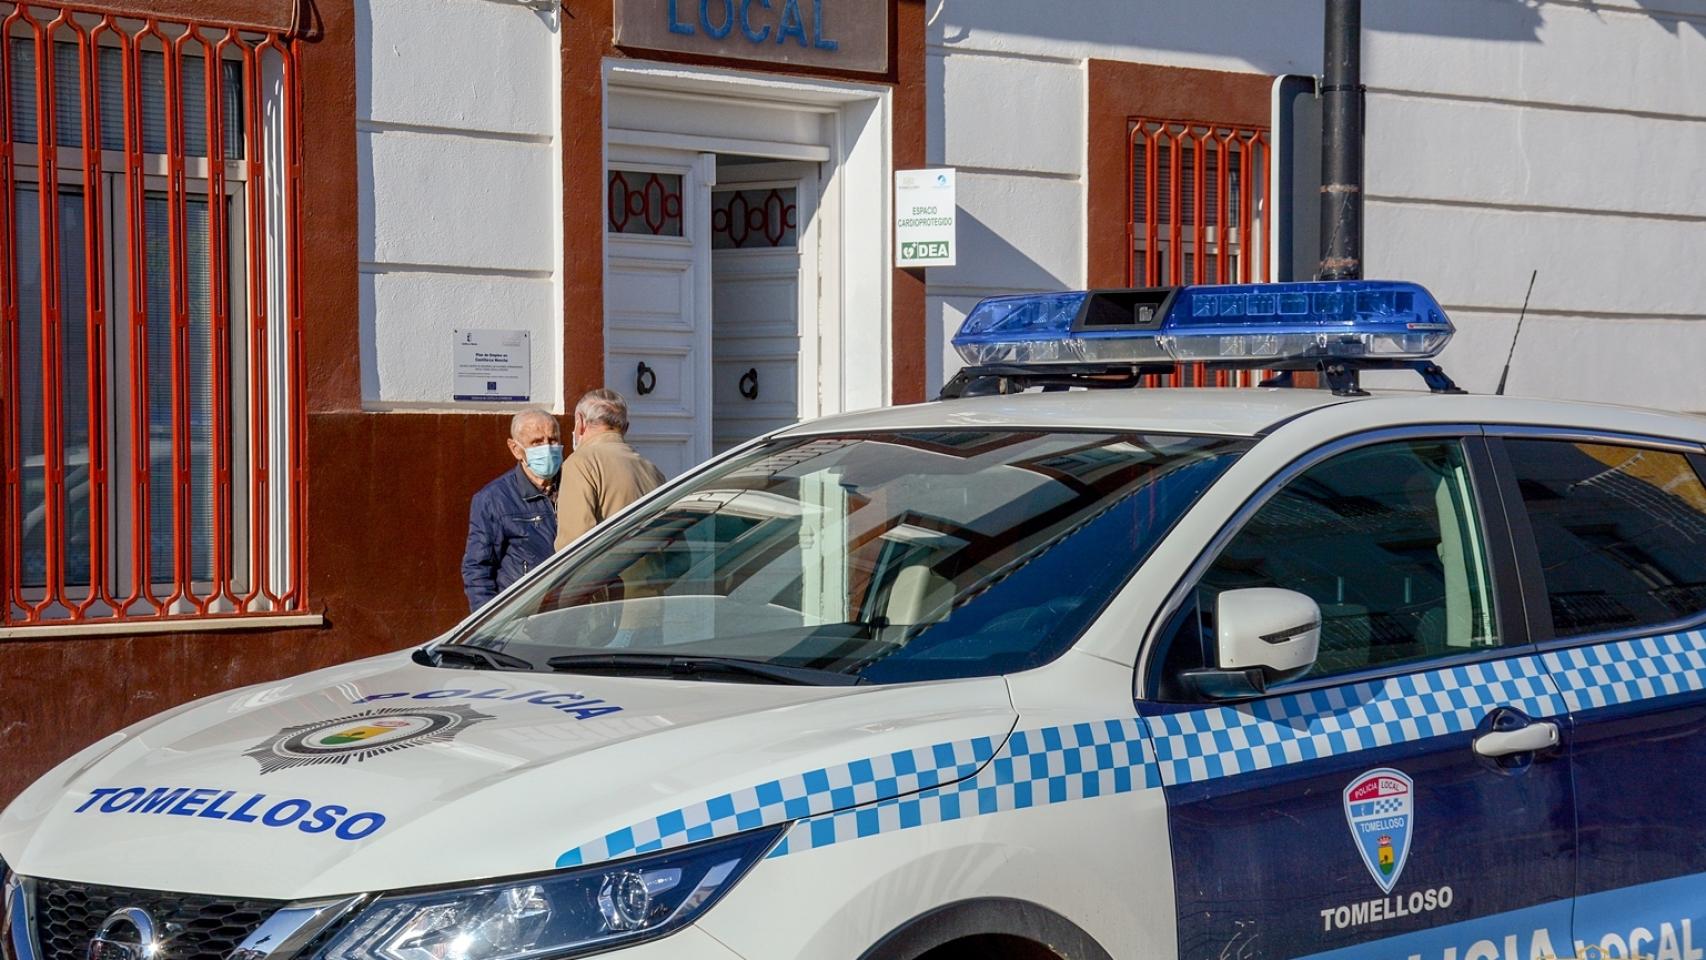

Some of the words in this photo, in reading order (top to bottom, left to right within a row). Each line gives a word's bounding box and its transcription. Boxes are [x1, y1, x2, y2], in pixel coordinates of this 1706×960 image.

[669, 0, 839, 50] LOCAL
[912, 206, 938, 215] ESPACIO
[898, 217, 953, 228] CARDIOPROTEGIDO
[918, 244, 948, 257] DEA
[353, 689, 624, 720] POLICIA
[1354, 781, 1378, 799] POLICIA
[1381, 780, 1400, 791] LOCAL
[75, 786, 387, 841] TOMELLOSO
[1360, 817, 1405, 833] TOMELLOSO
[1320, 886, 1454, 932] TOMELLOSO
